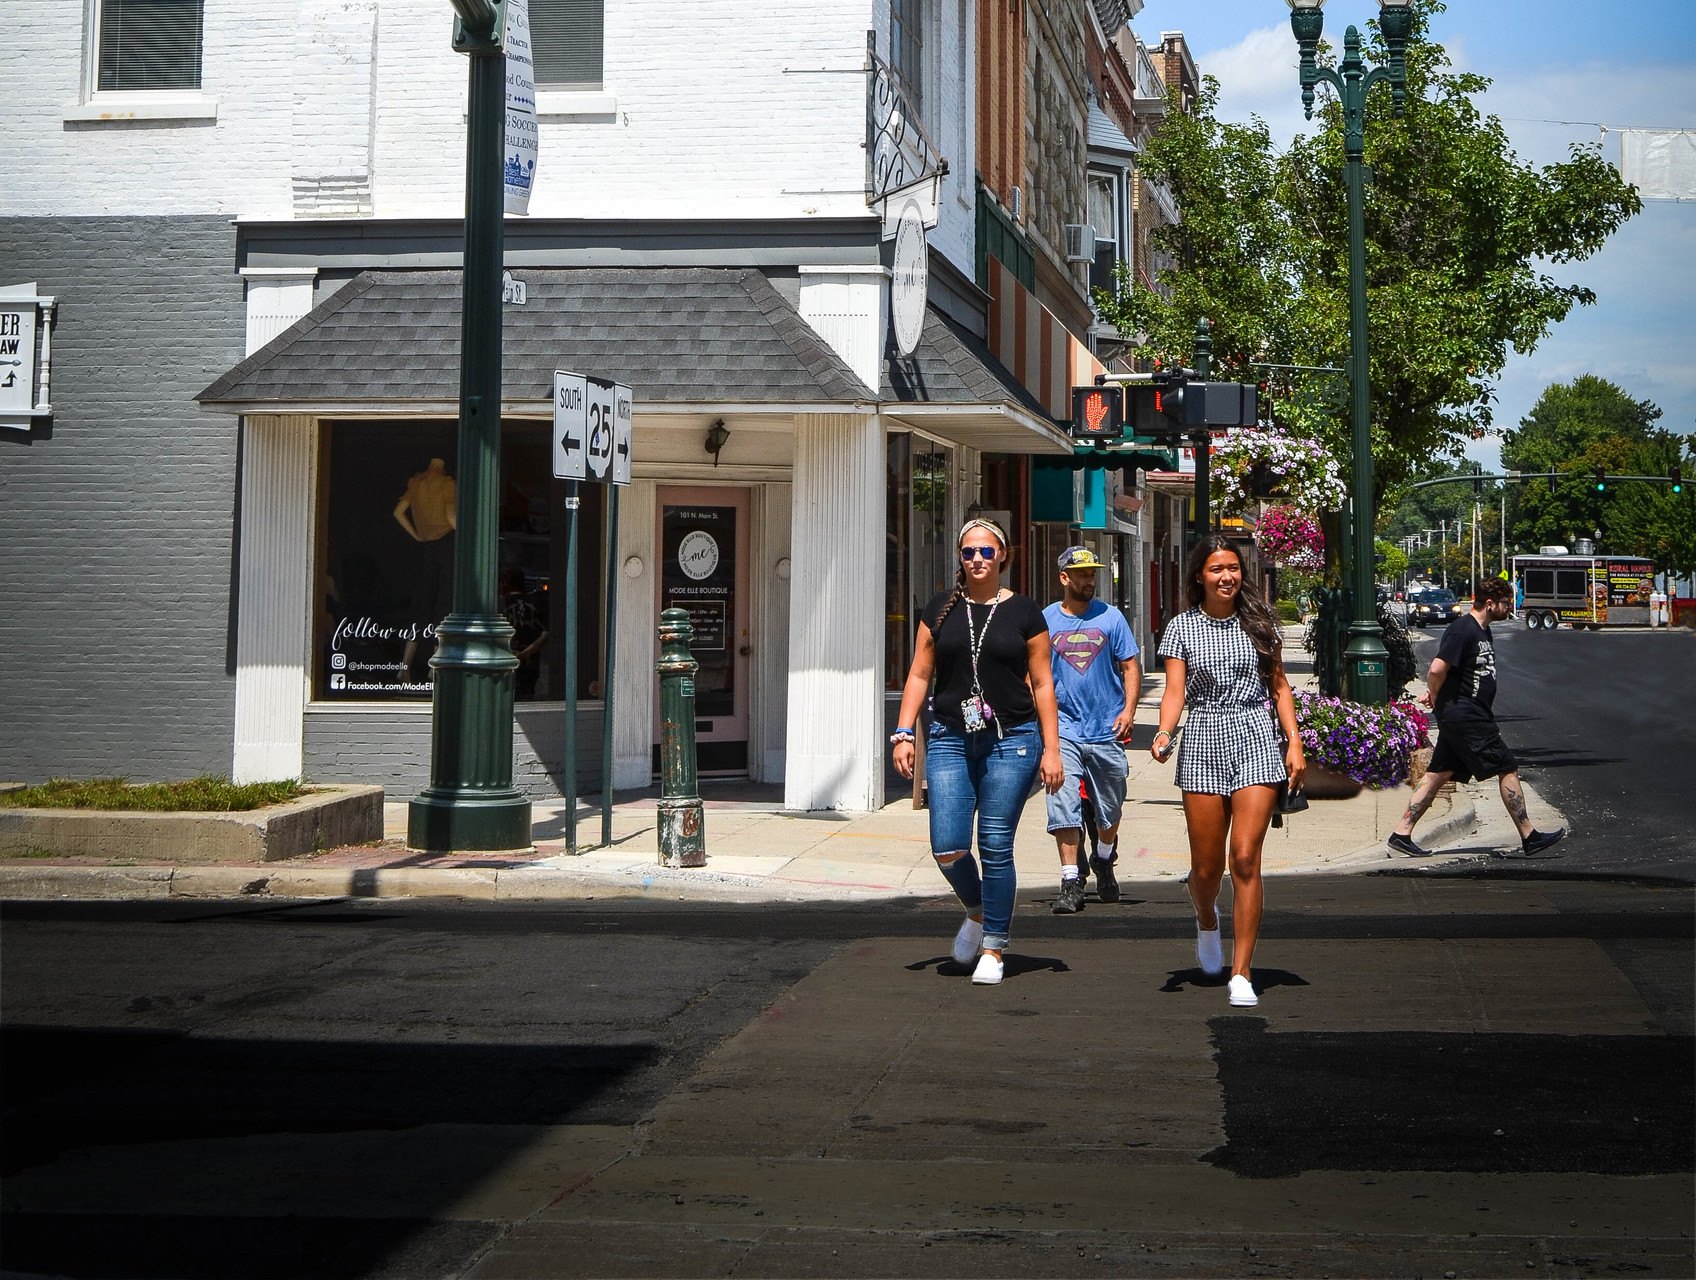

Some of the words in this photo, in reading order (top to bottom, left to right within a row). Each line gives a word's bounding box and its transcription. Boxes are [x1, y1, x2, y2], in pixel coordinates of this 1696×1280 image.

[0, 314, 20, 335] ER
[0, 340, 20, 354] AW
[560, 387, 582, 411] SOUTH
[590, 402, 611, 458] 25
[332, 616, 396, 651] follow
[398, 622, 420, 641] us
[423, 623, 438, 639] o
[348, 661, 408, 672] @shopmodeelle
[347, 681, 434, 691] Facebook.com/ModeEll
